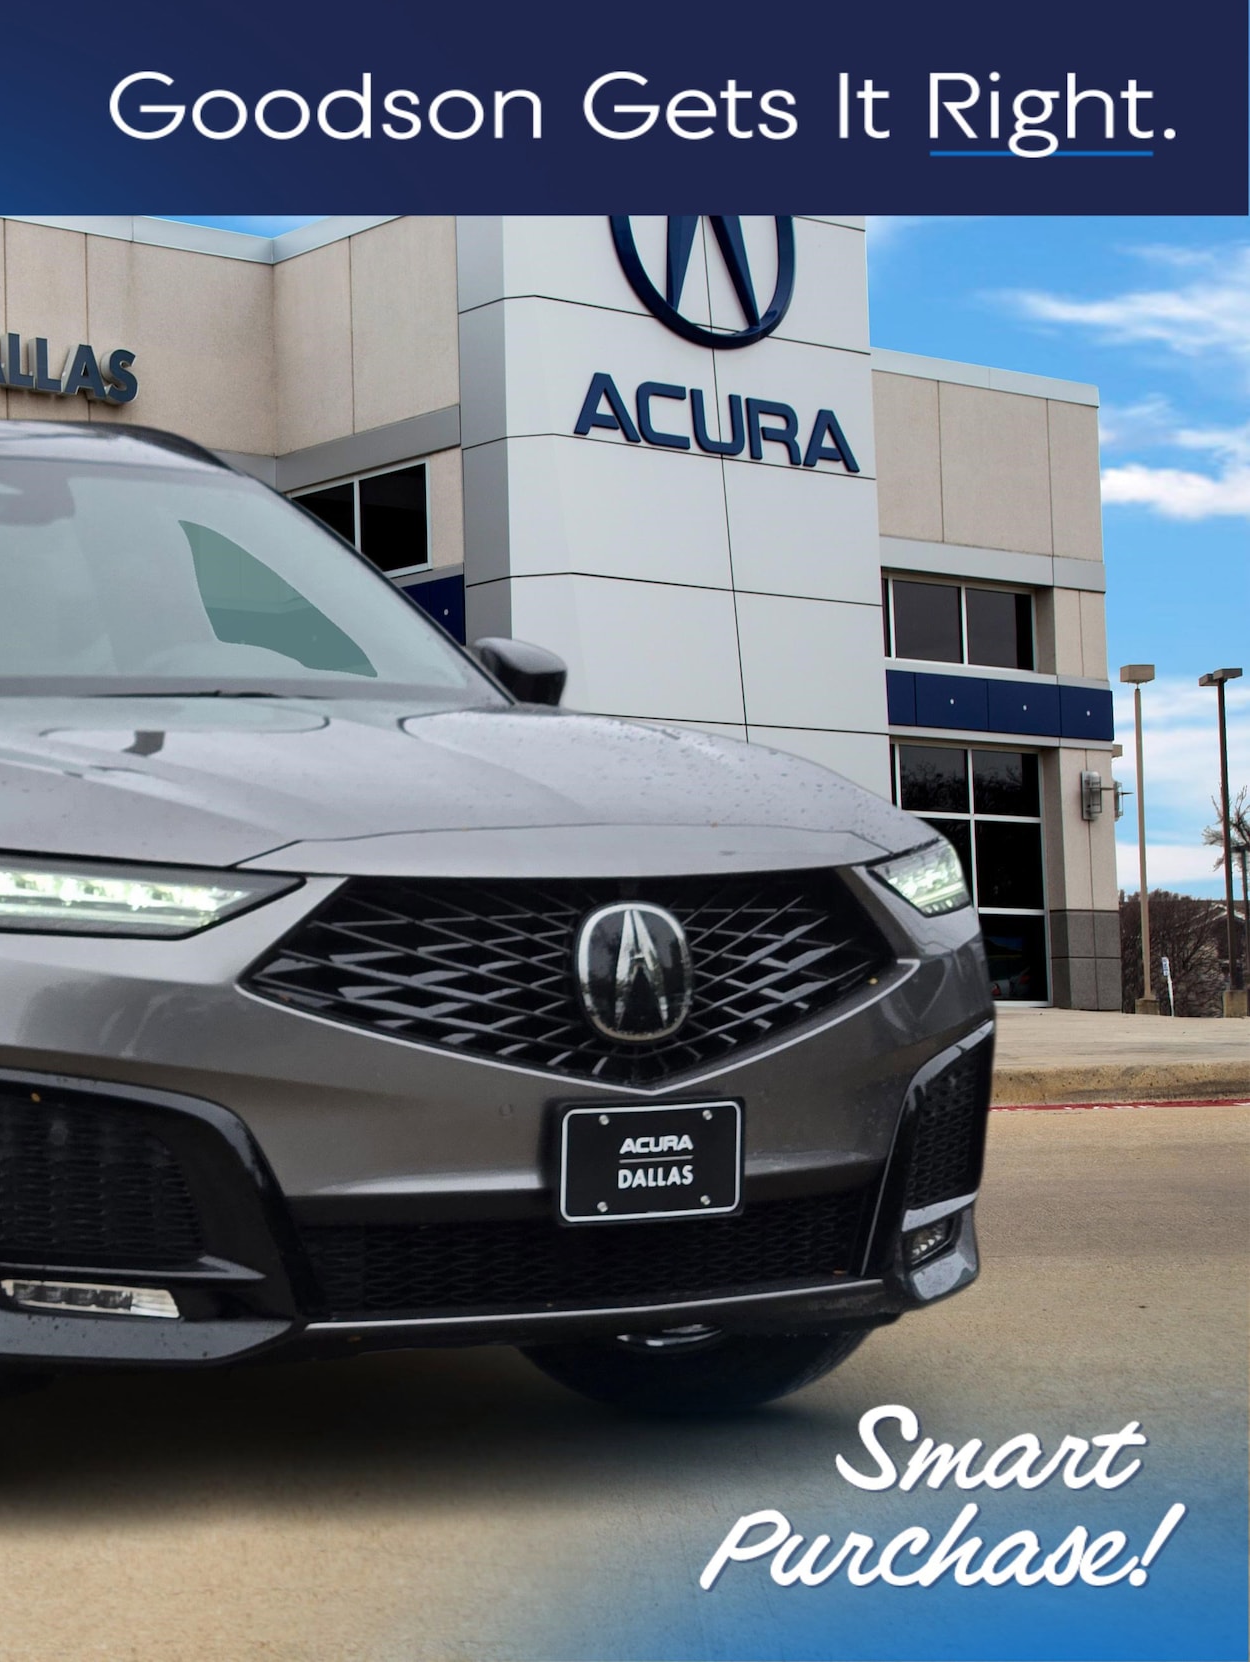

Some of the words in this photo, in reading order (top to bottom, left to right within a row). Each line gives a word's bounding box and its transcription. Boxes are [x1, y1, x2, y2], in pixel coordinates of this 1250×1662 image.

[573, 371, 861, 473] ACURA
[620, 1135, 693, 1154] ACURA
[618, 1165, 693, 1189] DALLAS
